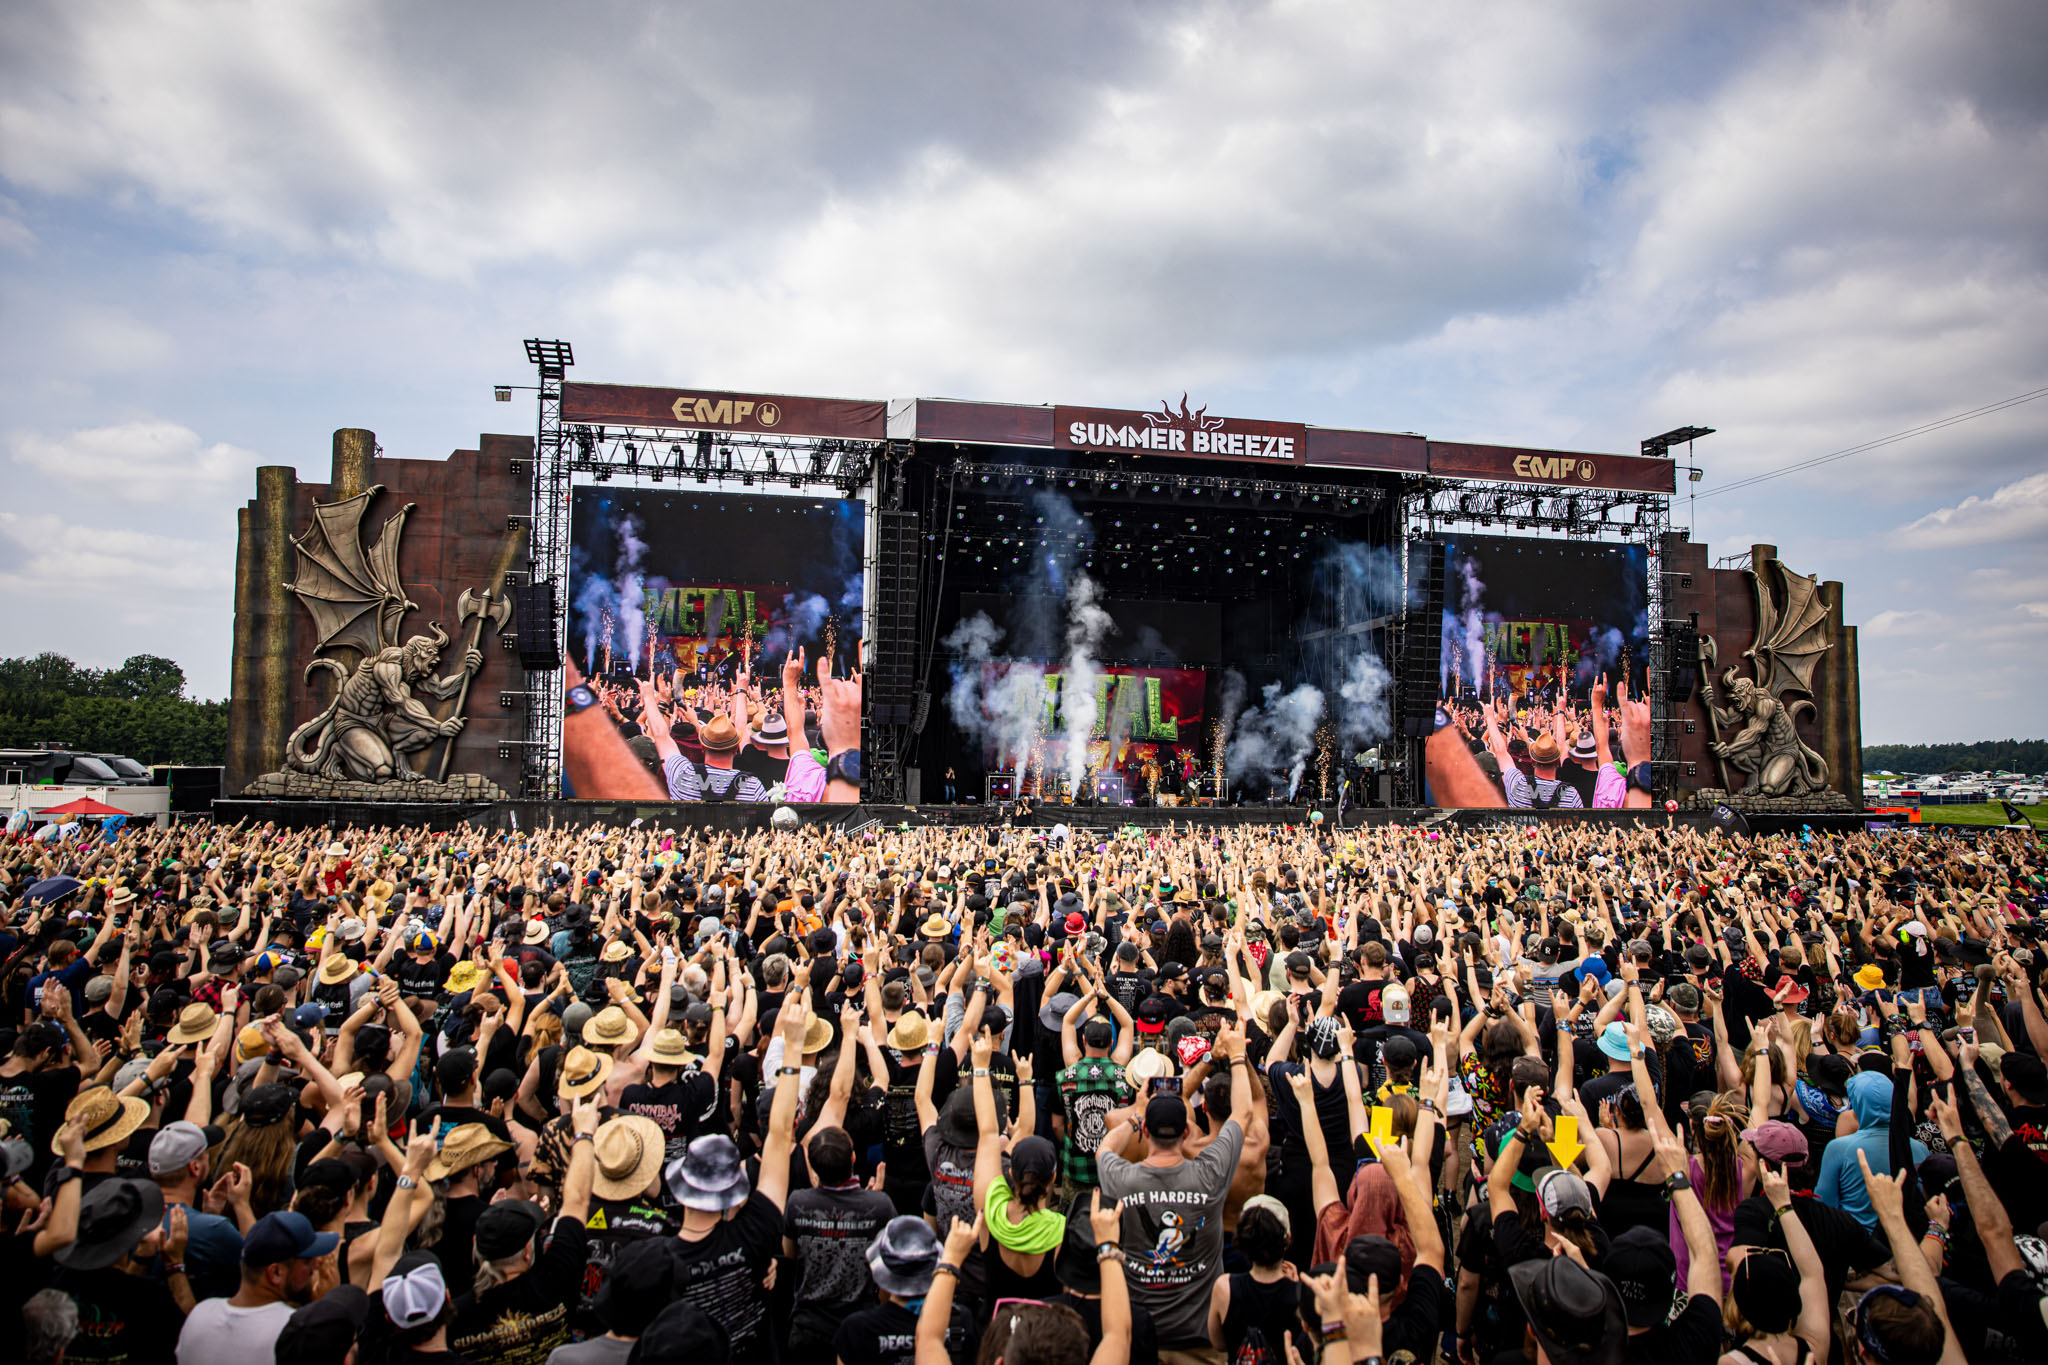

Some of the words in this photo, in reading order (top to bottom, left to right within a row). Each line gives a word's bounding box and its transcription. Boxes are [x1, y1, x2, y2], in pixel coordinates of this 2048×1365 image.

[672, 397, 755, 424] EMP
[1069, 421, 1186, 452] SUMMER
[1193, 430, 1295, 459] BREEZE
[1512, 455, 1576, 480] EMP
[1122, 1192, 1145, 1208] THE
[1149, 1191, 1208, 1205] HARDEST
